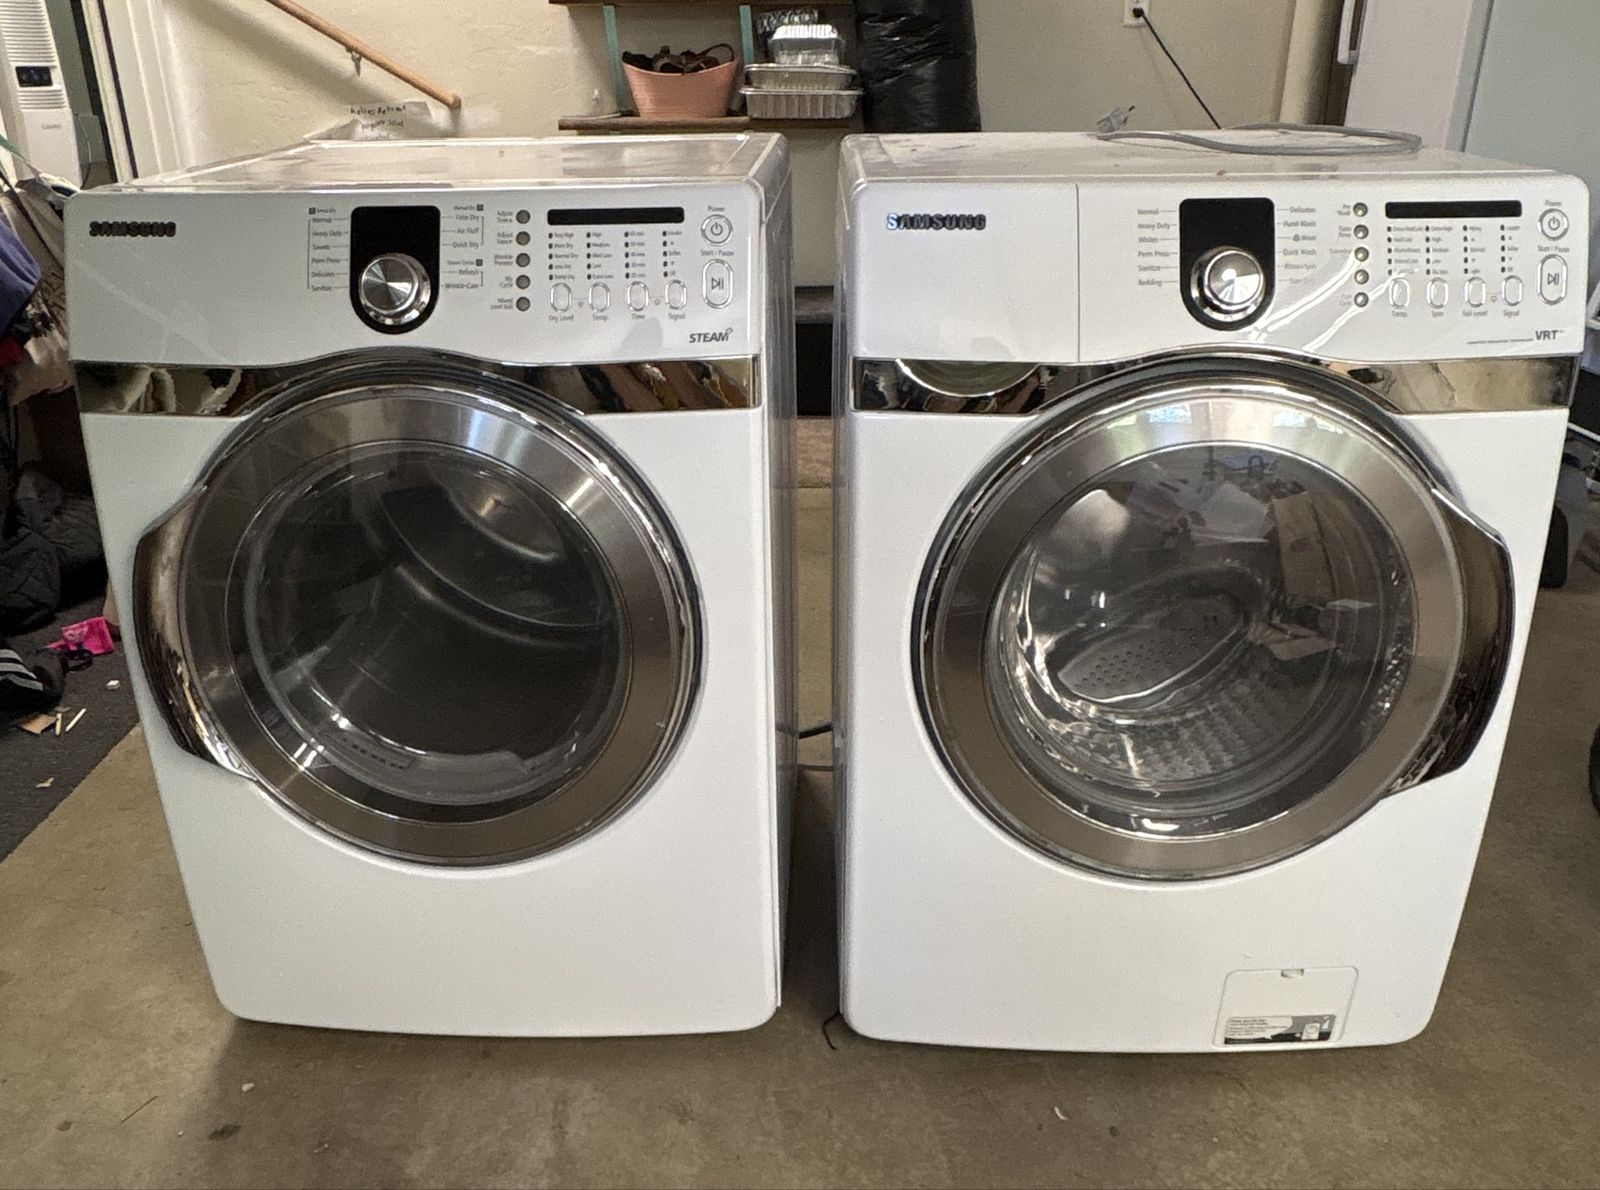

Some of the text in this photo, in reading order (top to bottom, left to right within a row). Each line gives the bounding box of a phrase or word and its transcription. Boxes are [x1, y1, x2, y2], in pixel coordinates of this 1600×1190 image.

[887, 212, 986, 231] SAMSUNG
[89, 221, 176, 237] SAMSUNG
[689, 330, 731, 343] STEAM
[1535, 330, 1559, 341] VRT
